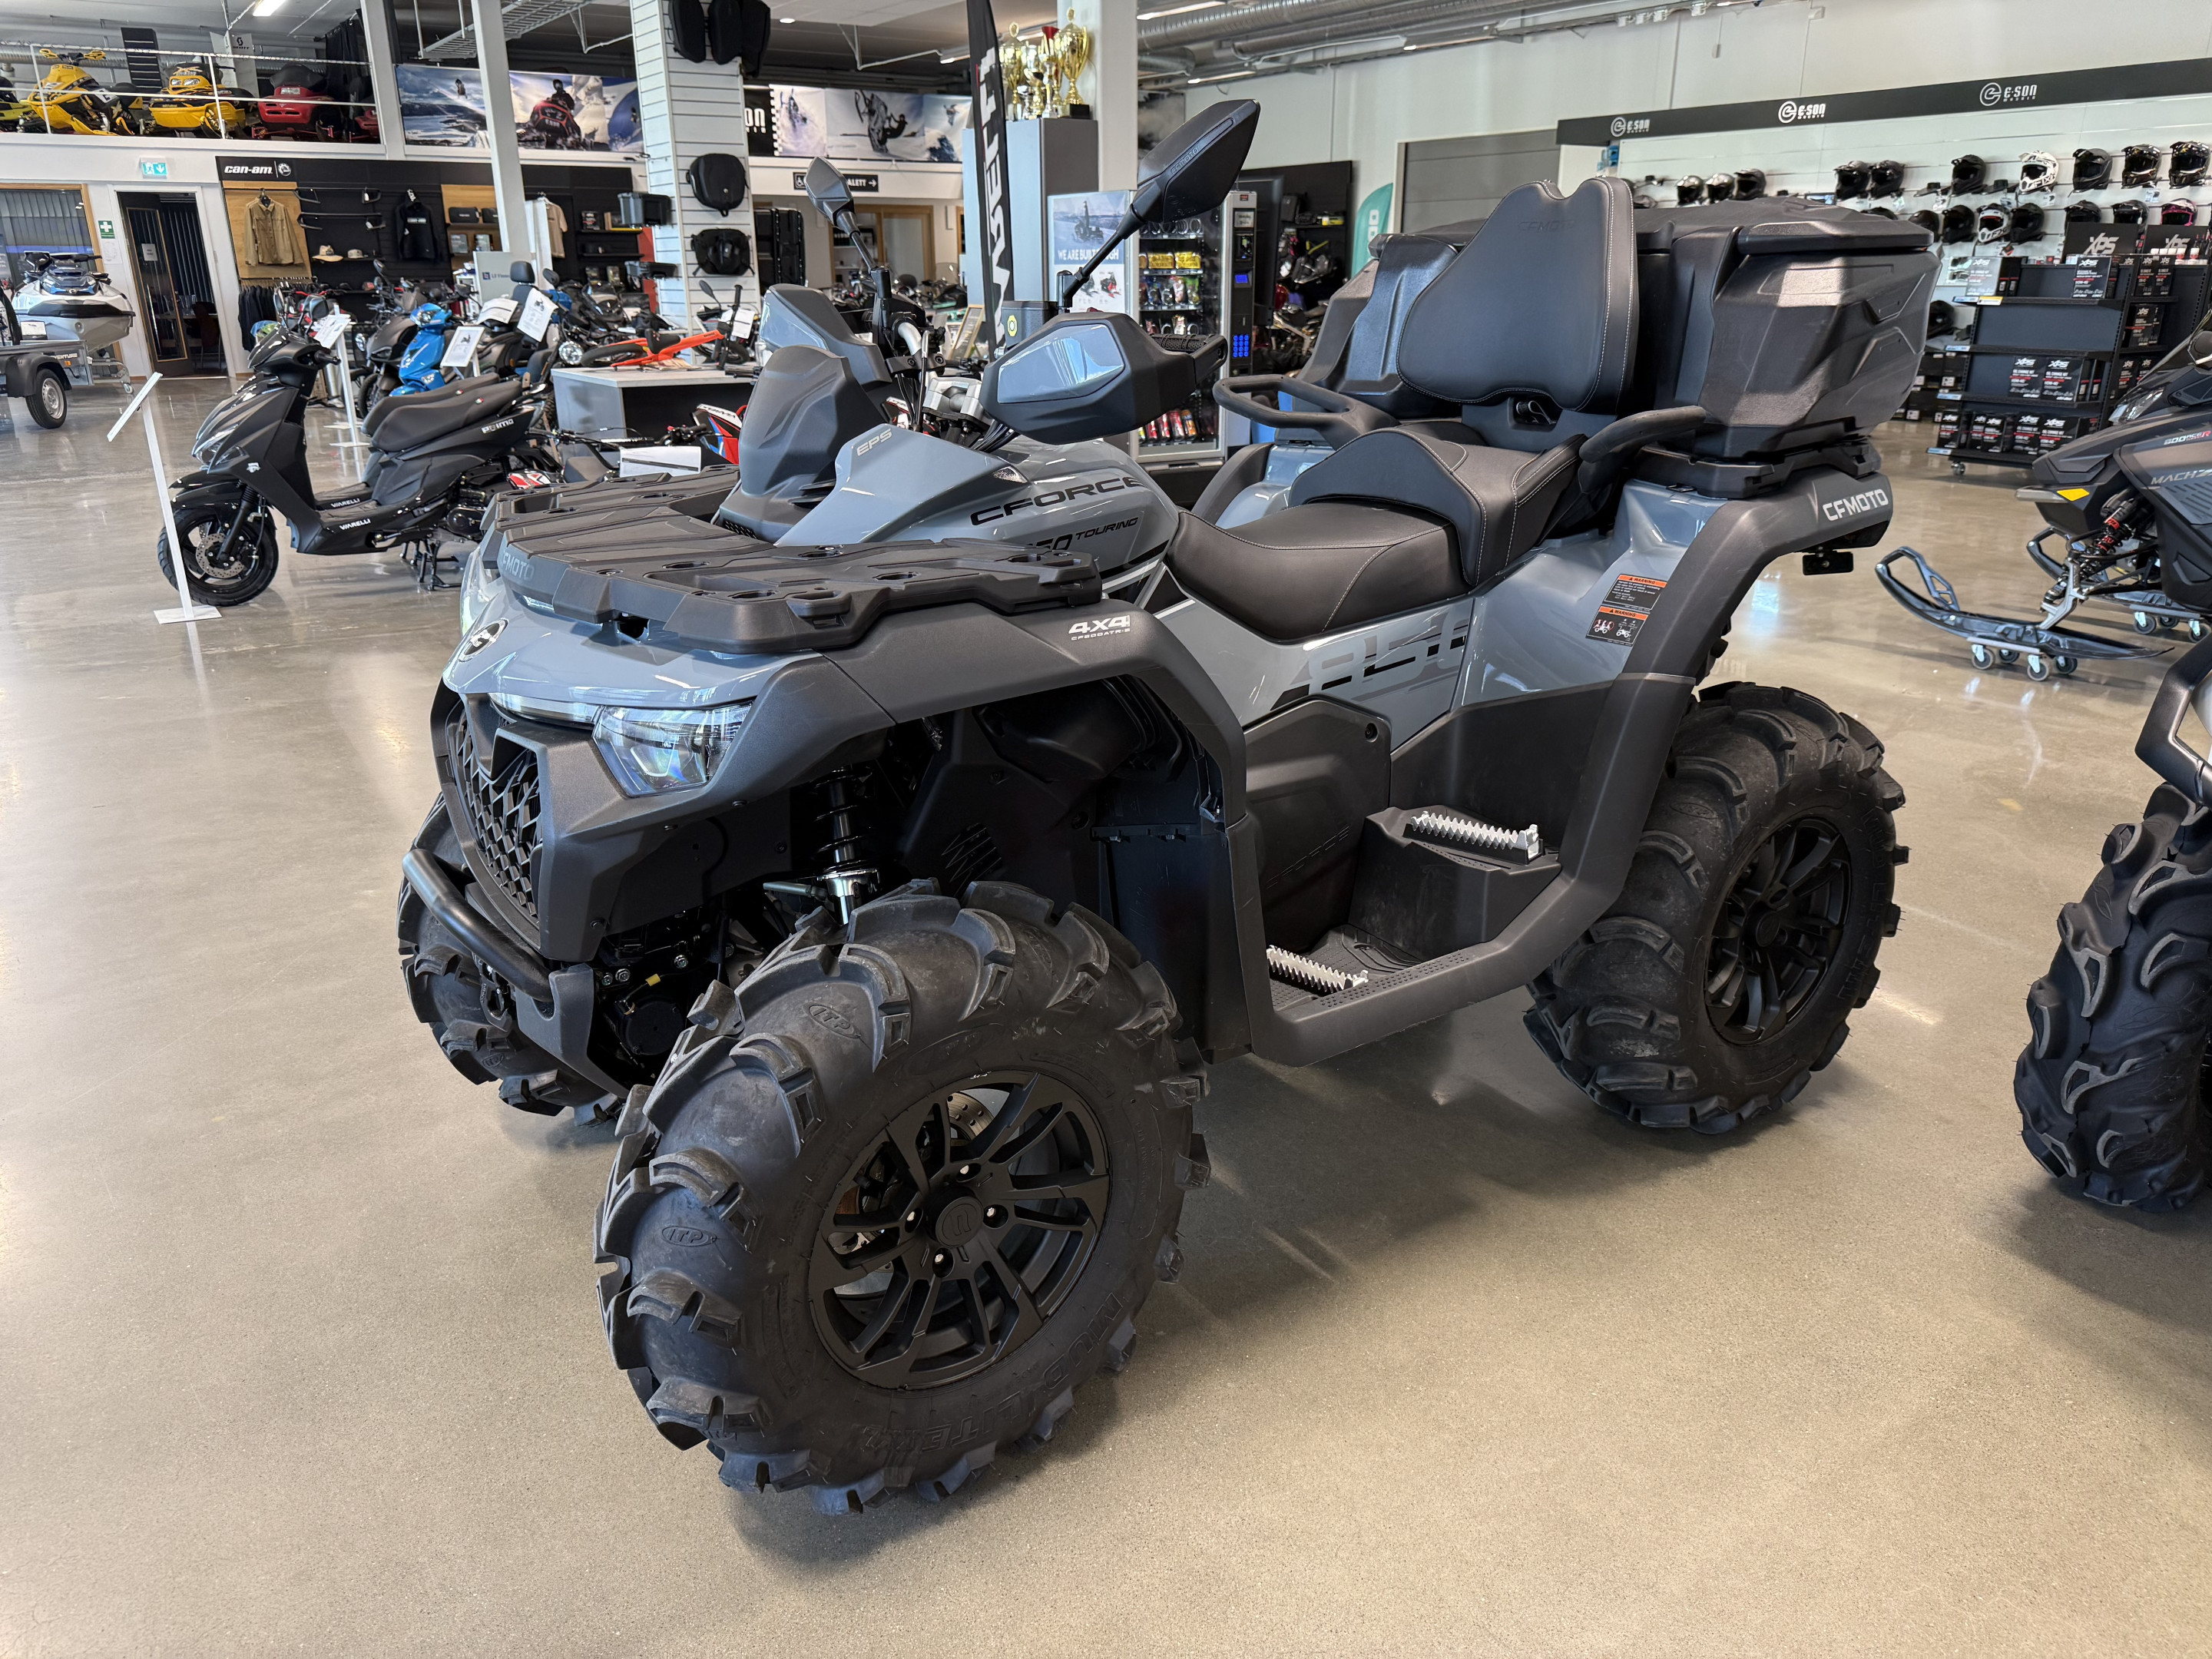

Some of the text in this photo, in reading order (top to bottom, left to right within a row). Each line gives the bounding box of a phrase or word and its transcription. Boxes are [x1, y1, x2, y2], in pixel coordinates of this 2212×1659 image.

[2083, 232, 2120, 255] XPS
[856, 429, 892, 456] EPS
[970, 476, 1145, 526] CFORCE
[1823, 489, 1889, 522] CFMOTO
[1076, 517, 1138, 541] TOURING
[502, 549, 535, 582] FMOTO
[810, 1007, 851, 1031] ITP
[669, 1228, 704, 1239] ITP
